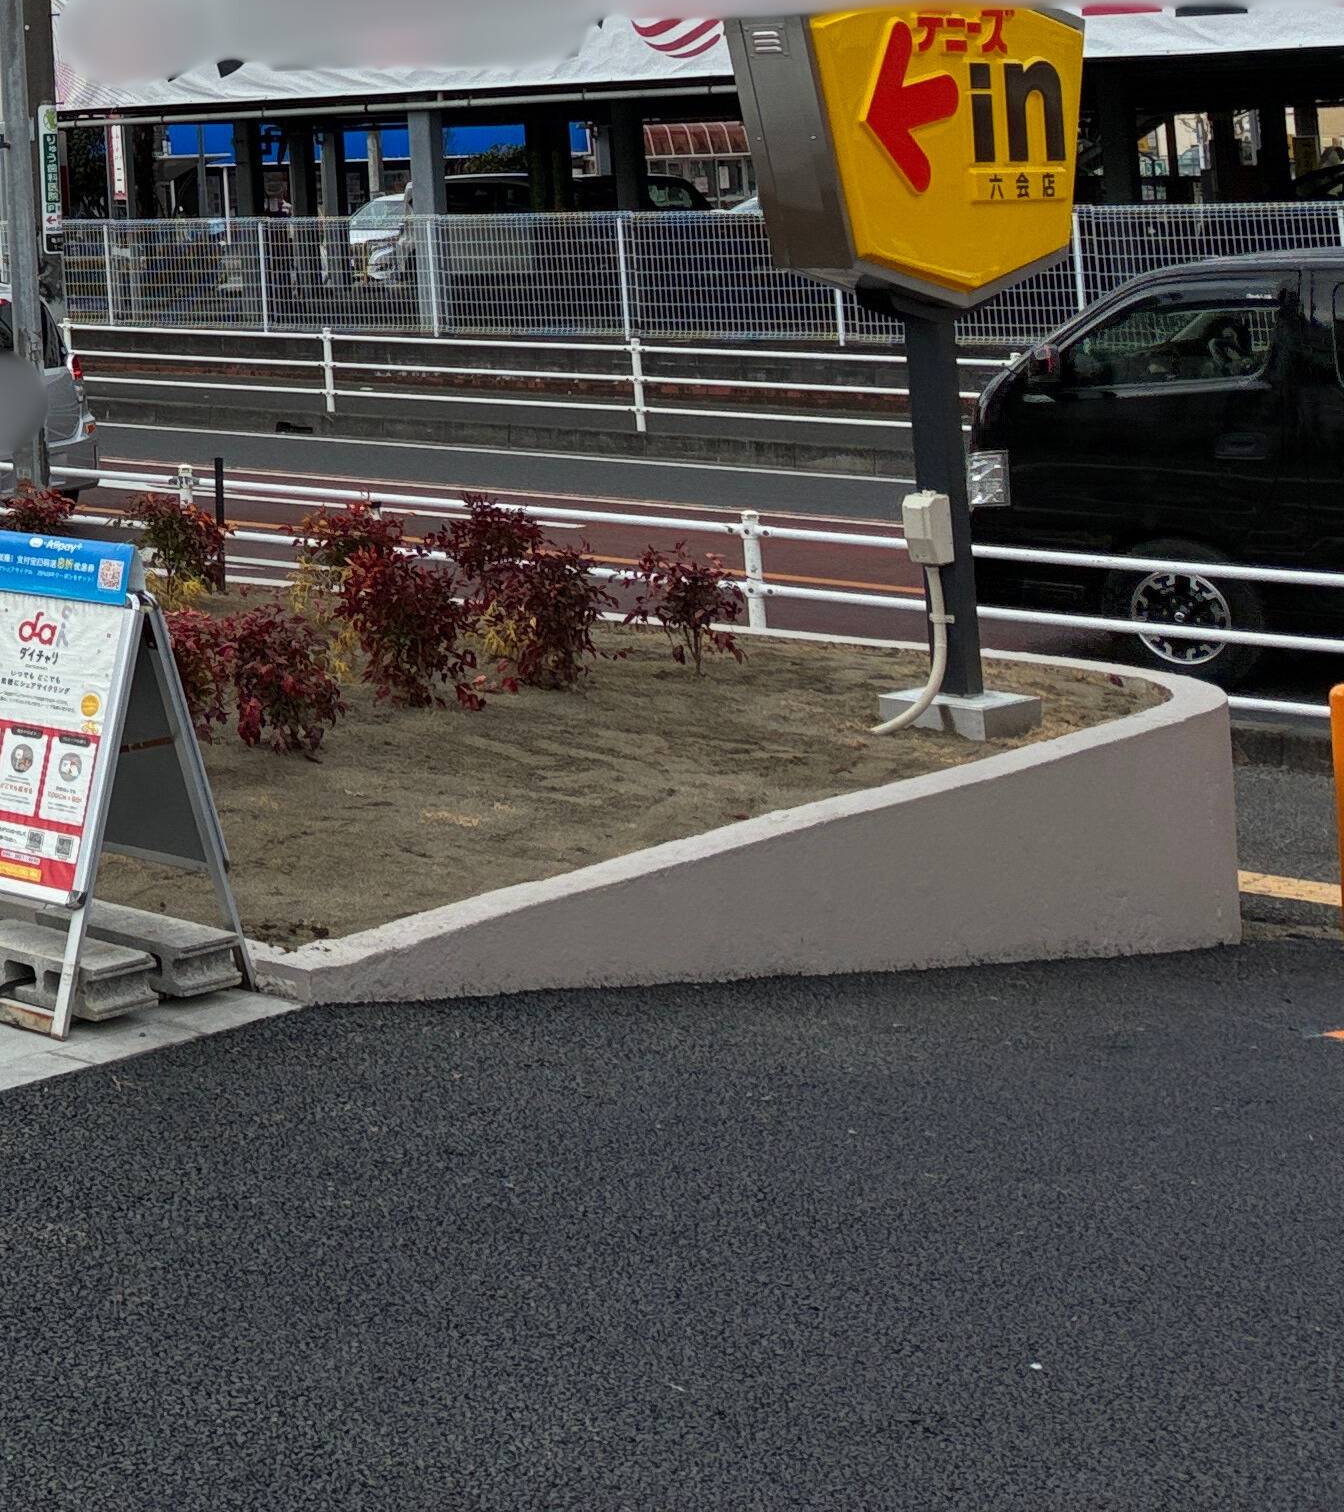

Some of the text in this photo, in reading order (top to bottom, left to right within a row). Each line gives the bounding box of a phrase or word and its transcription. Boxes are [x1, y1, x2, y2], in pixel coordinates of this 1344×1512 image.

[969, 60, 1066, 163] in
[989, 172, 1055, 199] 六会店
[19, 646, 59, 665] ダイチャリ
